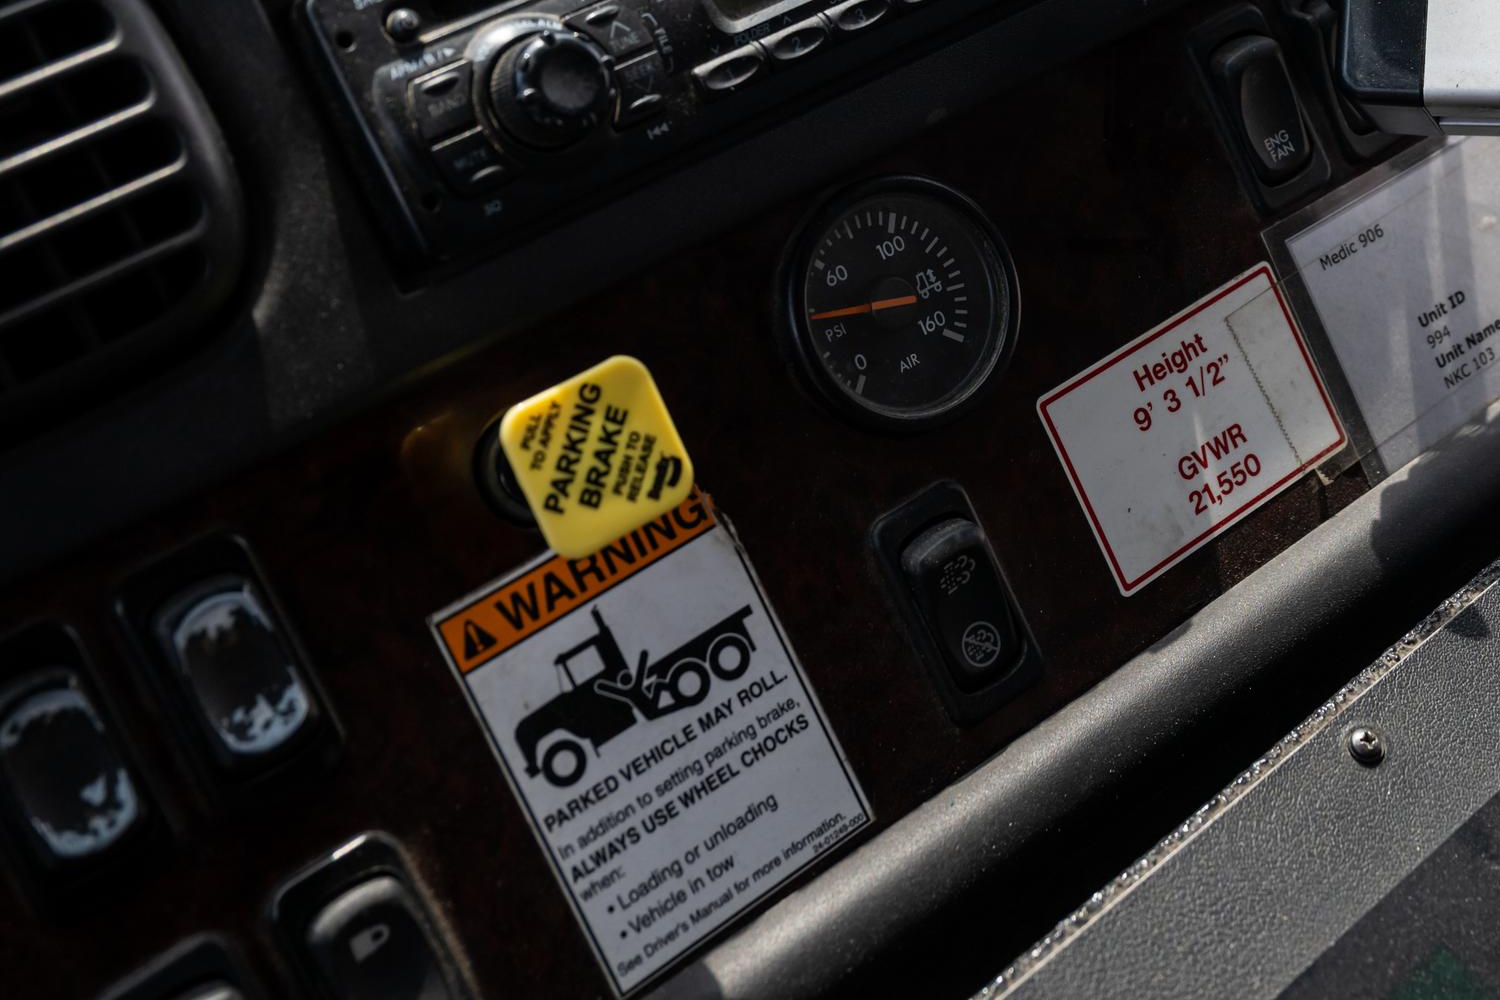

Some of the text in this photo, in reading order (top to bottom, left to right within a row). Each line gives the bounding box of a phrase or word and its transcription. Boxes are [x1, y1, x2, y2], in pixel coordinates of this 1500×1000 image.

[733, 22, 772, 46] FOLDER
[854, 7, 866, 24] 3
[791, 36, 802, 52] 2
[1263, 129, 1290, 149] ENG
[1270, 142, 1296, 163] FAN
[875, 236, 905, 261] 100
[1319, 223, 1385, 271] Medic 906
[826, 264, 848, 287] 60
[917, 311, 946, 336] 160
[1417, 290, 1467, 329] Unit ID
[825, 324, 848, 343] PSI
[1426, 325, 1451, 350] 994
[854, 353, 868, 370] 0
[899, 353, 921, 373] AIR
[1132, 333, 1210, 393] Height
[1434, 344, 1464, 370] Unit
[1443, 346, 1496, 389] NKC 103
[1163, 388, 1182, 413] 3
[530, 450, 546, 471] TO
[543, 382, 602, 515] PARKING
[578, 405, 629, 510] BRAKE
[613, 431, 640, 496] PUSH TO
[1177, 422, 1248, 481] GVWR
[626, 434, 657, 503] RELEASE
[1187, 453, 1262, 516] 21,550
[494, 495, 709, 632] WARNING
[544, 669, 789, 834] PARKED VEHICLE MAY ROLL.
[558, 698, 801, 861] In addition to setting parking brake,
[570, 714, 810, 884] ALWAYS USE WHEEL CHOCKS
[616, 794, 779, 912] Loading or unloading
[580, 867, 626, 903] when:
[617, 812, 847, 978] See Driver's Manual for more information.
[626, 856, 735, 937] Vehicle in tow
